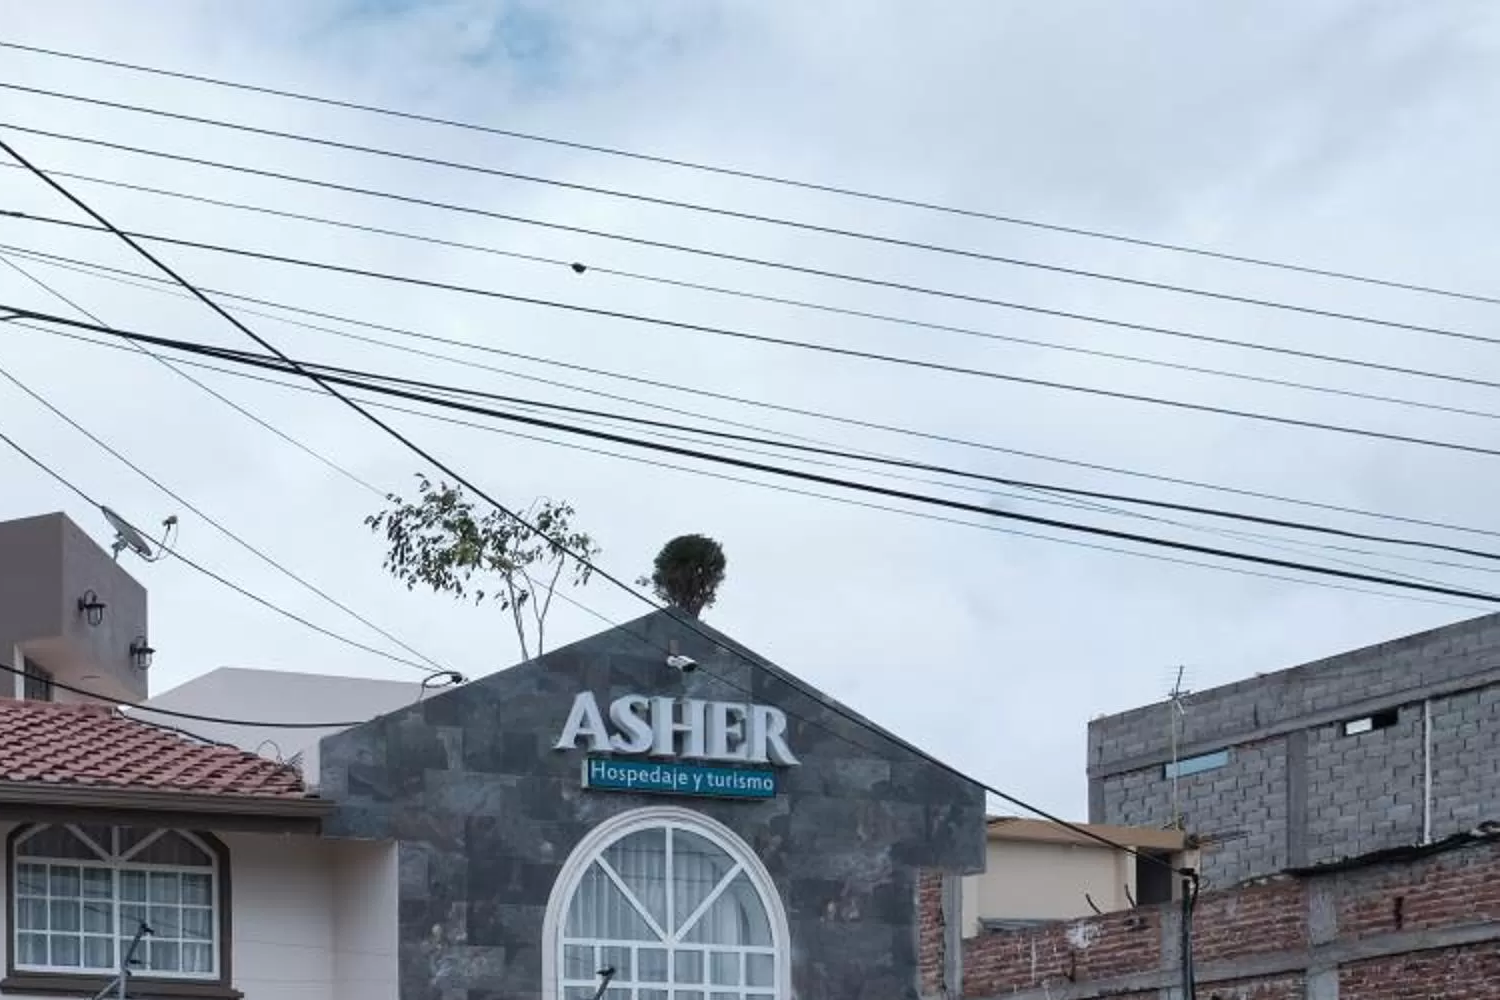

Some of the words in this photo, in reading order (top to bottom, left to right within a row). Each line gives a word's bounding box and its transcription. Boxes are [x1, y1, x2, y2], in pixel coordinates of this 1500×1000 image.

[552, 690, 800, 765] ASHER
[590, 760, 688, 790] Hospedaje
[693, 773, 705, 791] y
[707, 771, 775, 791] turismo
